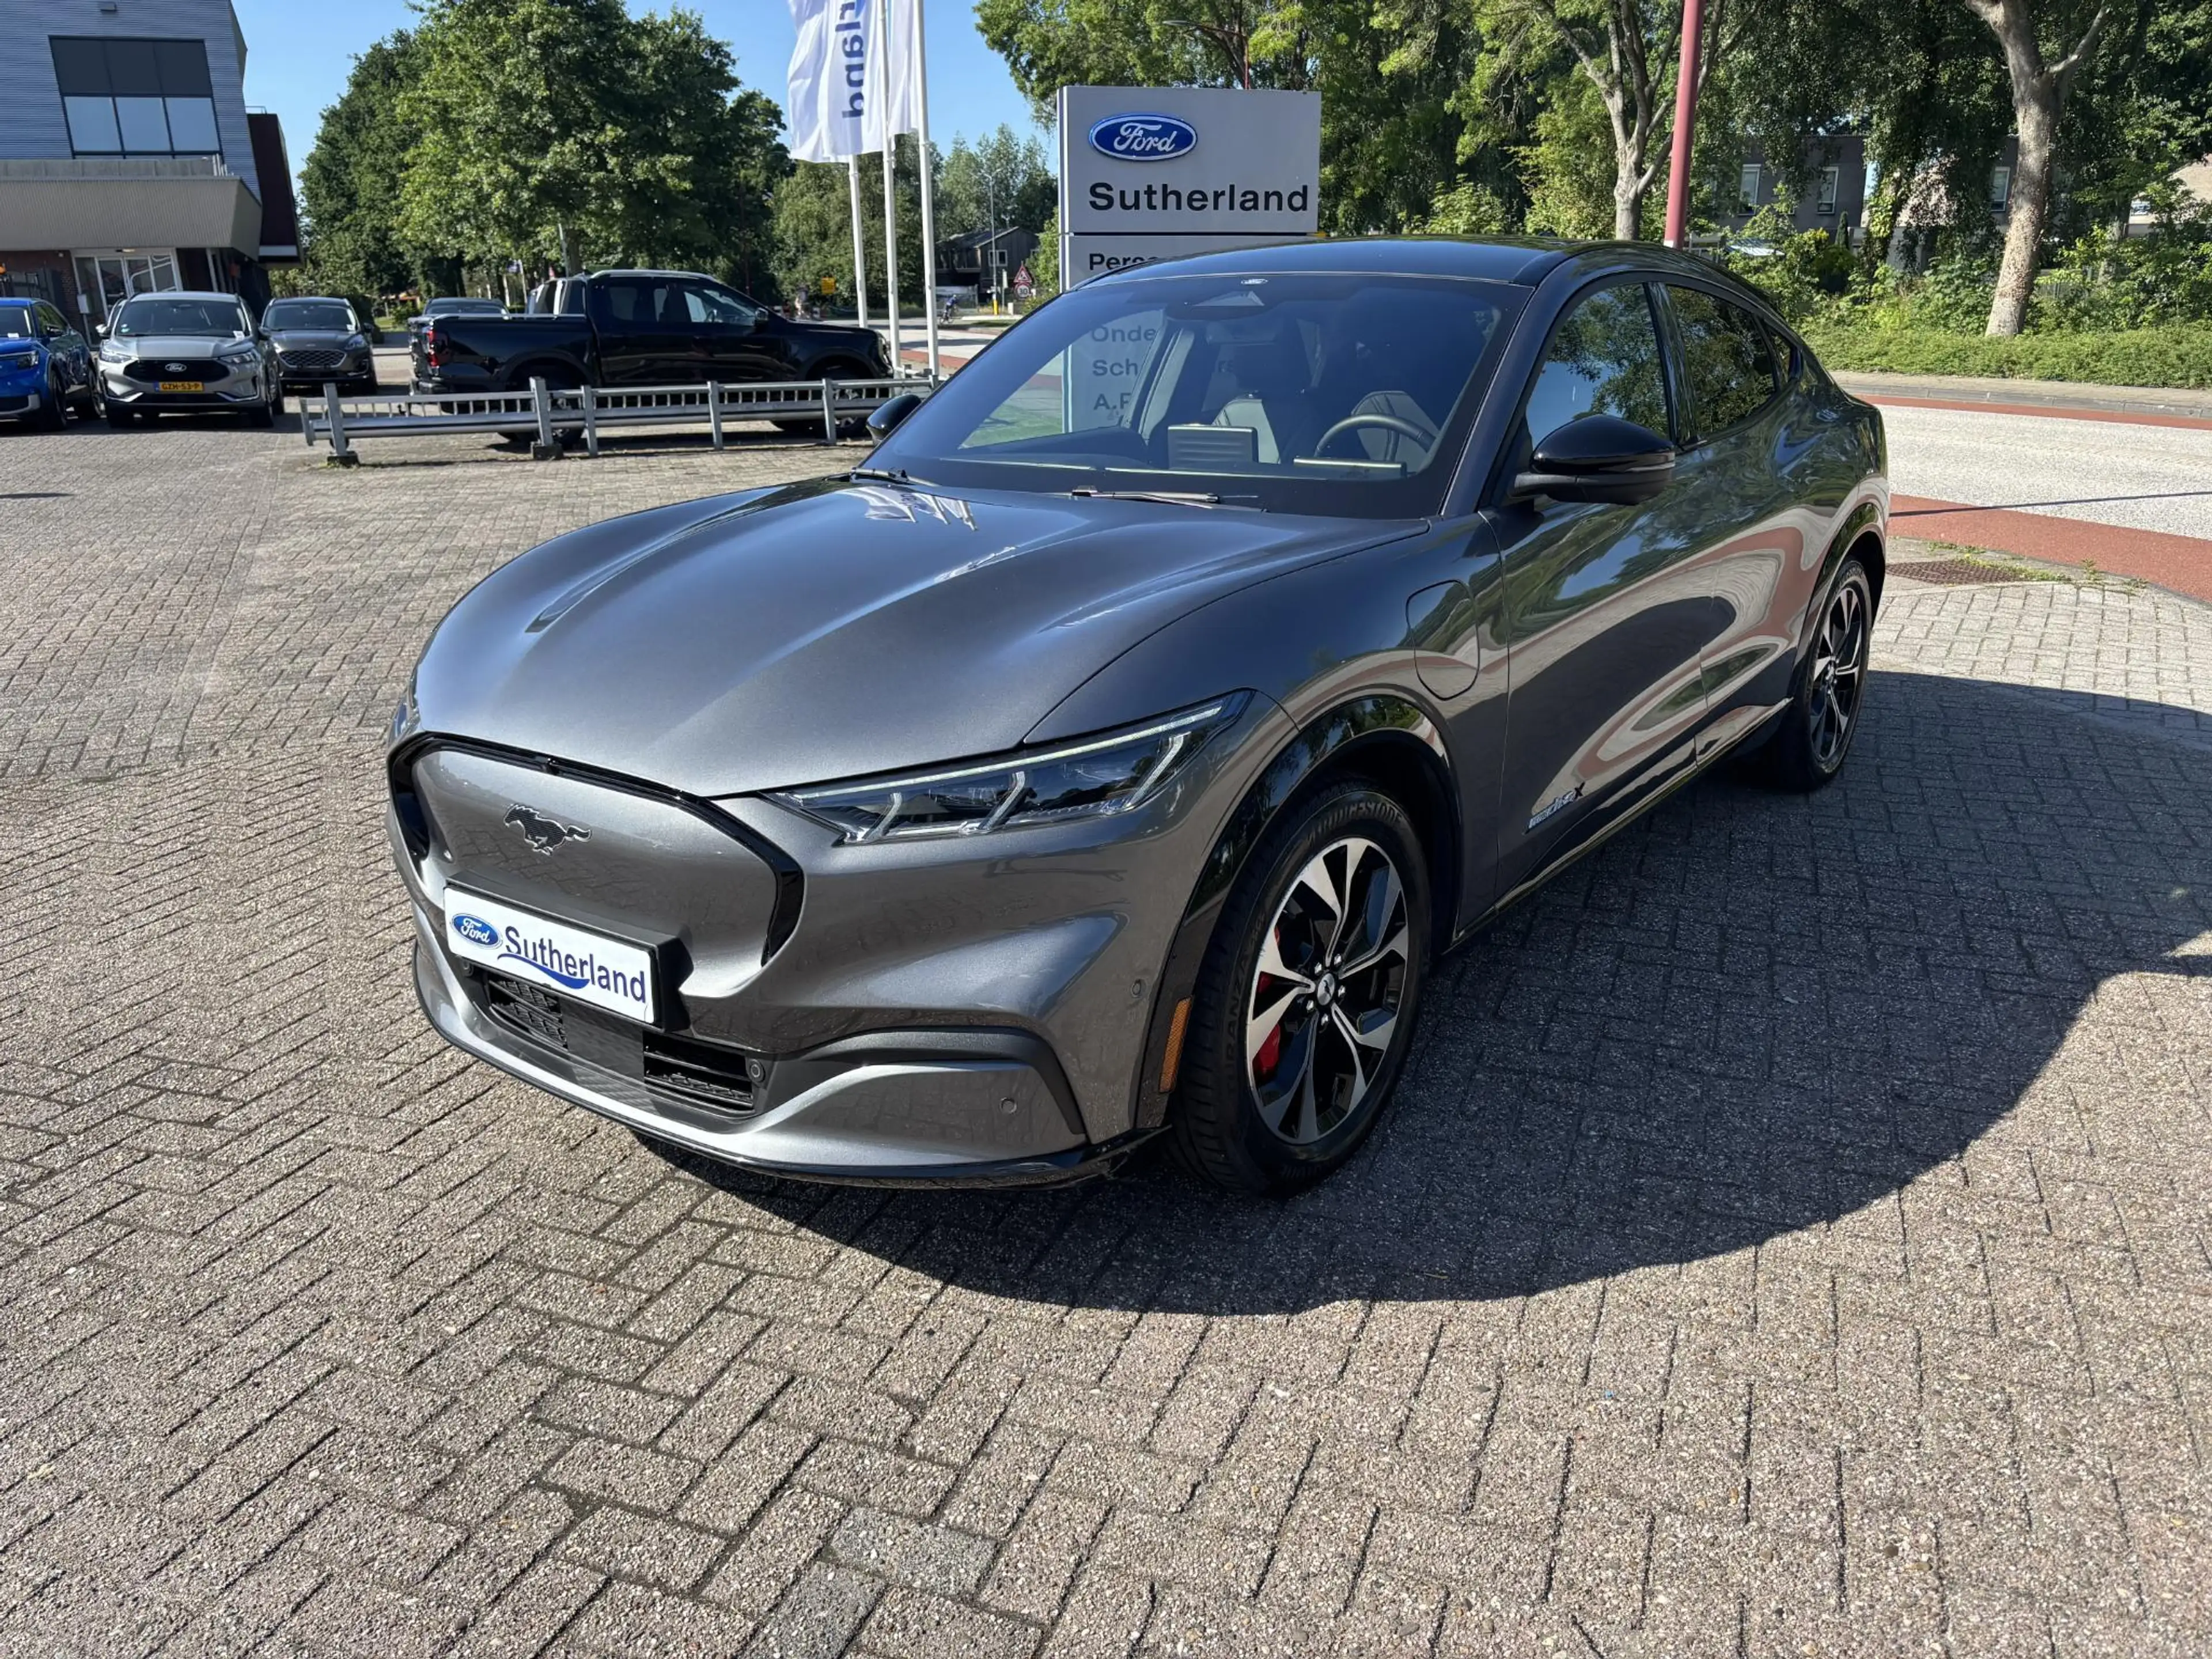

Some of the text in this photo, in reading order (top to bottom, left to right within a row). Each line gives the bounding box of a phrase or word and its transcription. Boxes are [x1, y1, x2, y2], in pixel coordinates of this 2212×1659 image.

[1113, 123, 1177, 152] Ford
[1089, 183, 1308, 211] Sutherland
[1092, 358, 1138, 376] Sch
[461, 918, 490, 943] Ford
[505, 926, 646, 1003] Sutherland
